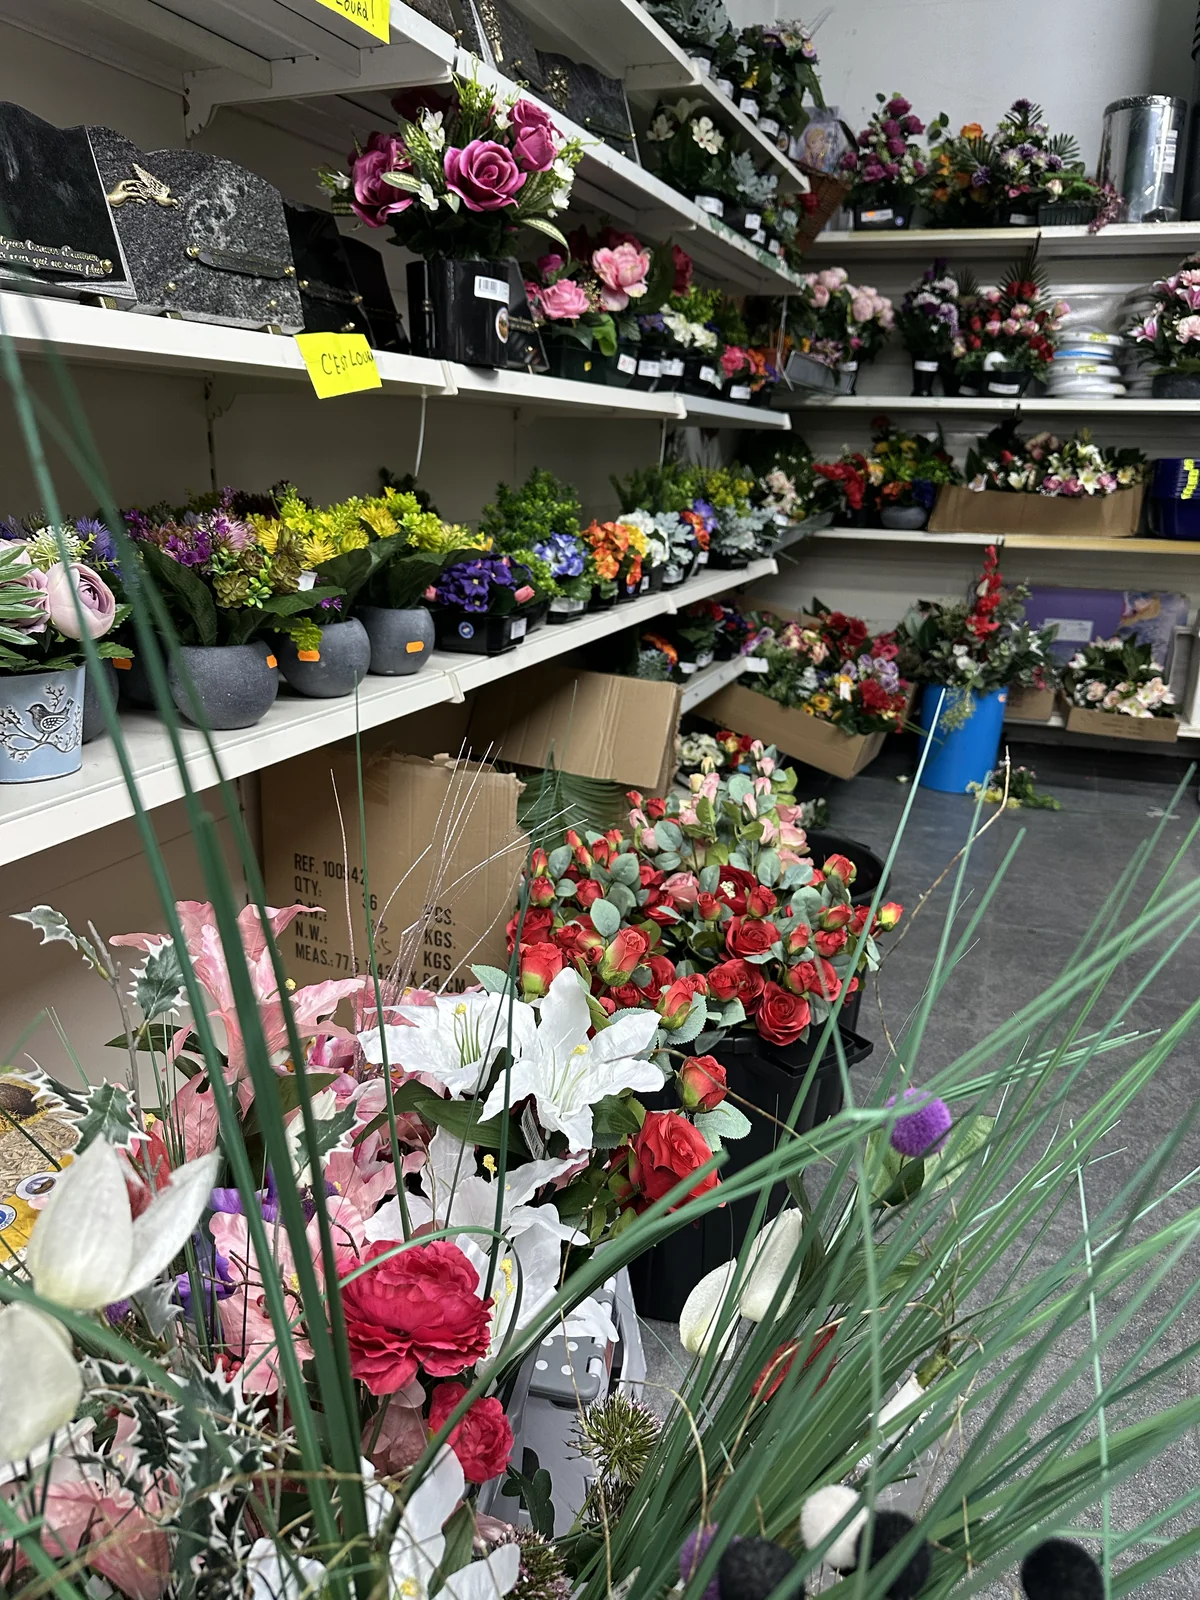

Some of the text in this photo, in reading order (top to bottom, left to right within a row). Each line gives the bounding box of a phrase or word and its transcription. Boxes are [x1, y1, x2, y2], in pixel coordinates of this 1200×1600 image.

[294, 852, 319, 875] REF.
[294, 875, 322, 897] QTY:
[296, 920, 328, 944] N.W.:
[424, 928, 456, 949] KGS.
